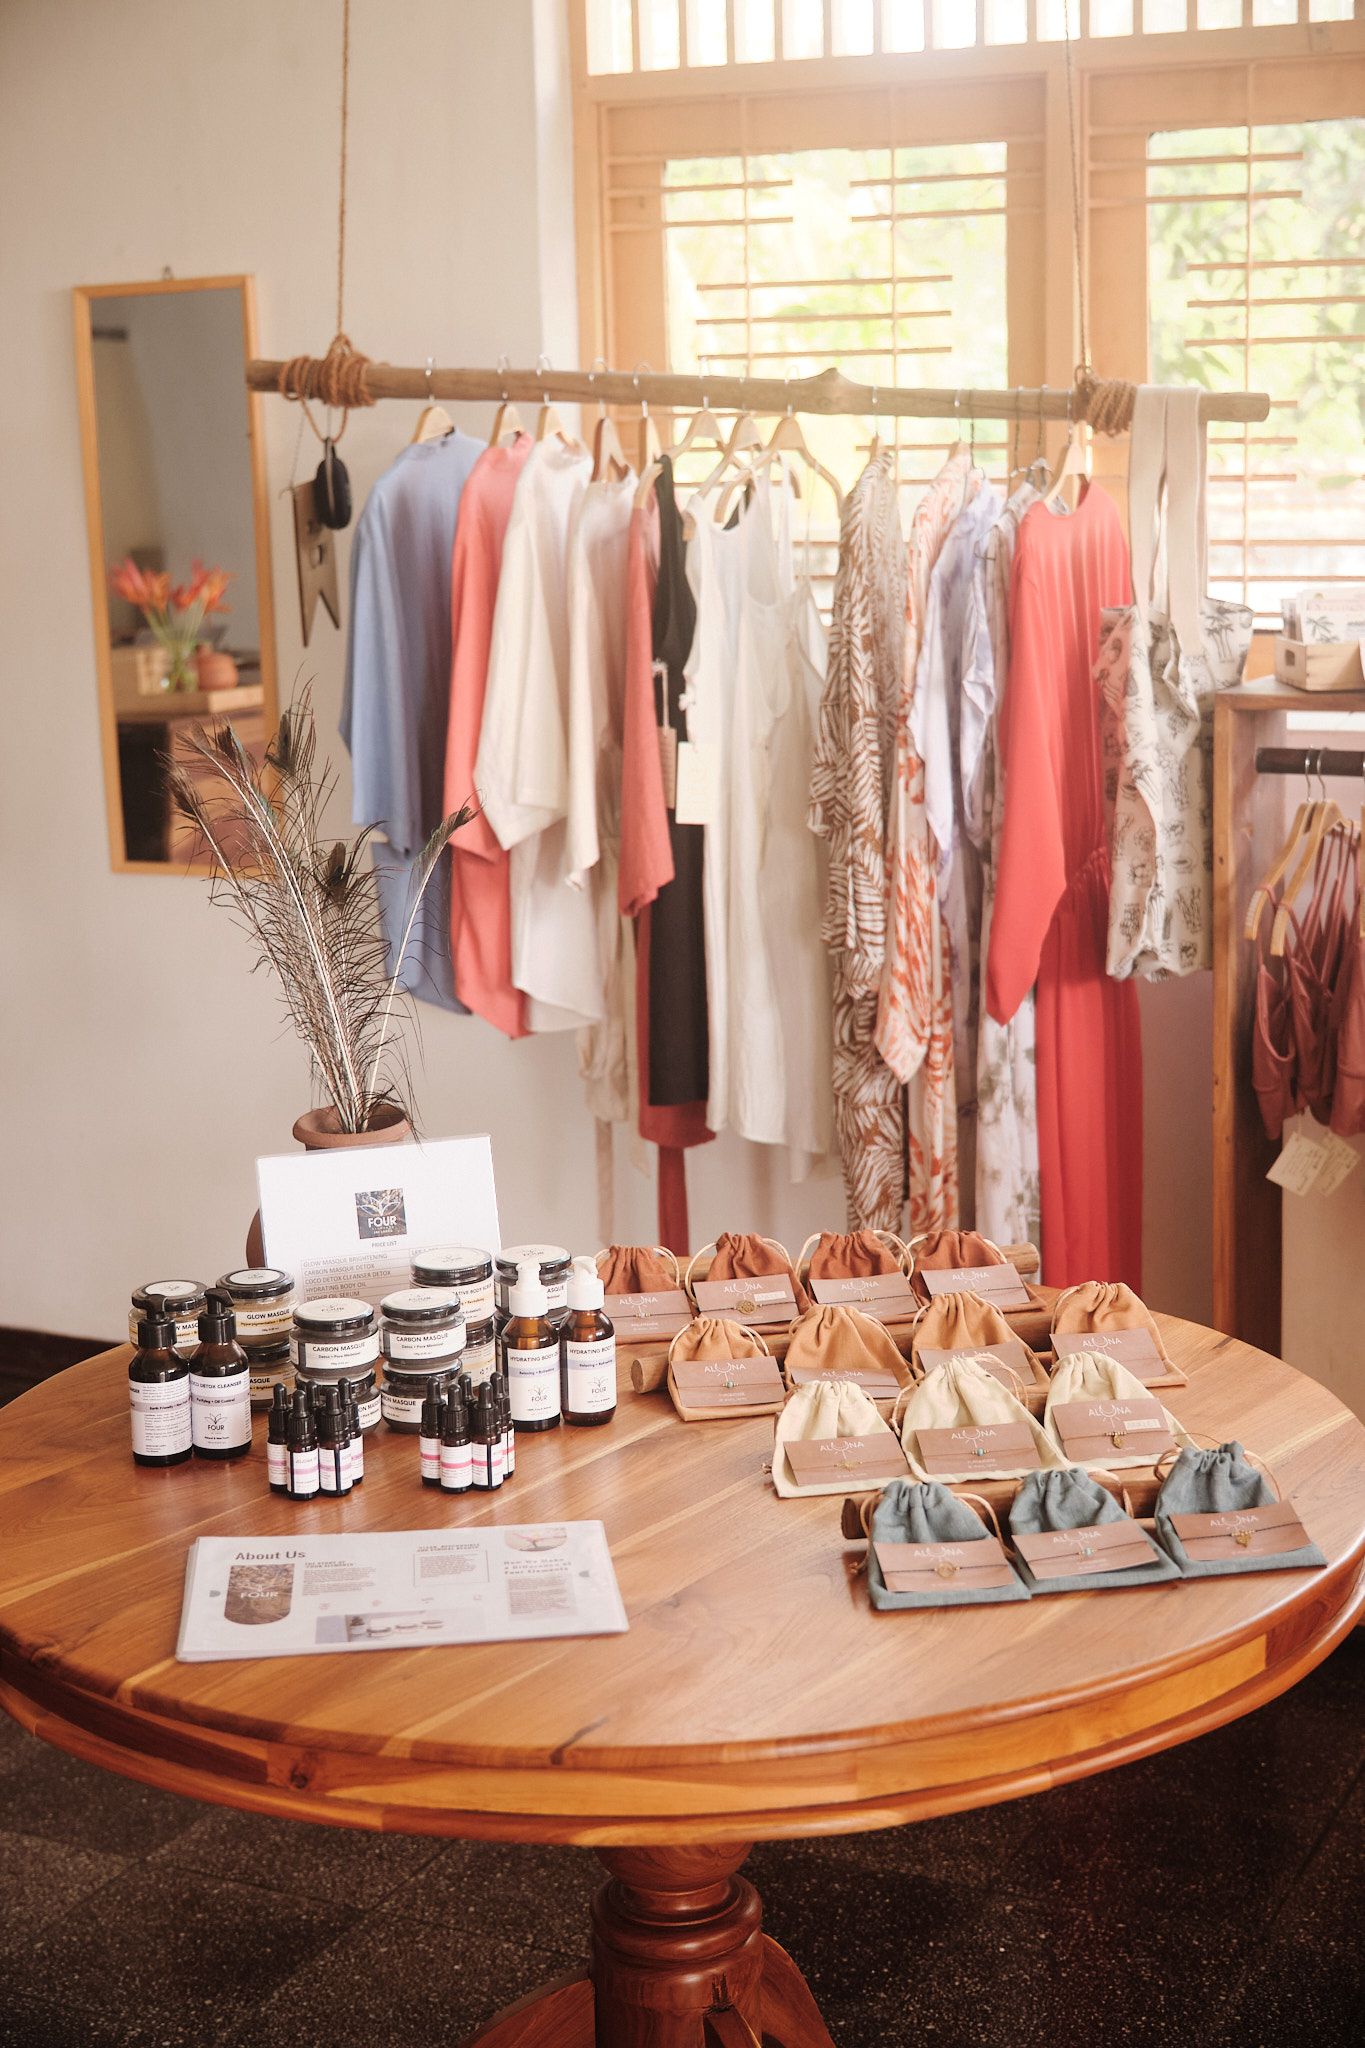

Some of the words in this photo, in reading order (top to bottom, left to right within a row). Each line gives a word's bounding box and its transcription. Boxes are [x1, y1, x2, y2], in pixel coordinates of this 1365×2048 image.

[368, 1216, 397, 1228] FOUR
[349, 1254, 388, 1262] BRIGHTENING
[306, 1284, 339, 1293] HYDRATING
[547, 1285, 564, 1293] ASQUE
[268, 1309, 290, 1318] MASQUE
[341, 1342, 365, 1350] MASQUE
[217, 1380, 241, 1388] CLEANSER
[1088, 1405, 1132, 1417] ALUNA
[952, 1429, 996, 1440] ALUNA
[235, 1552, 280, 1561] About
